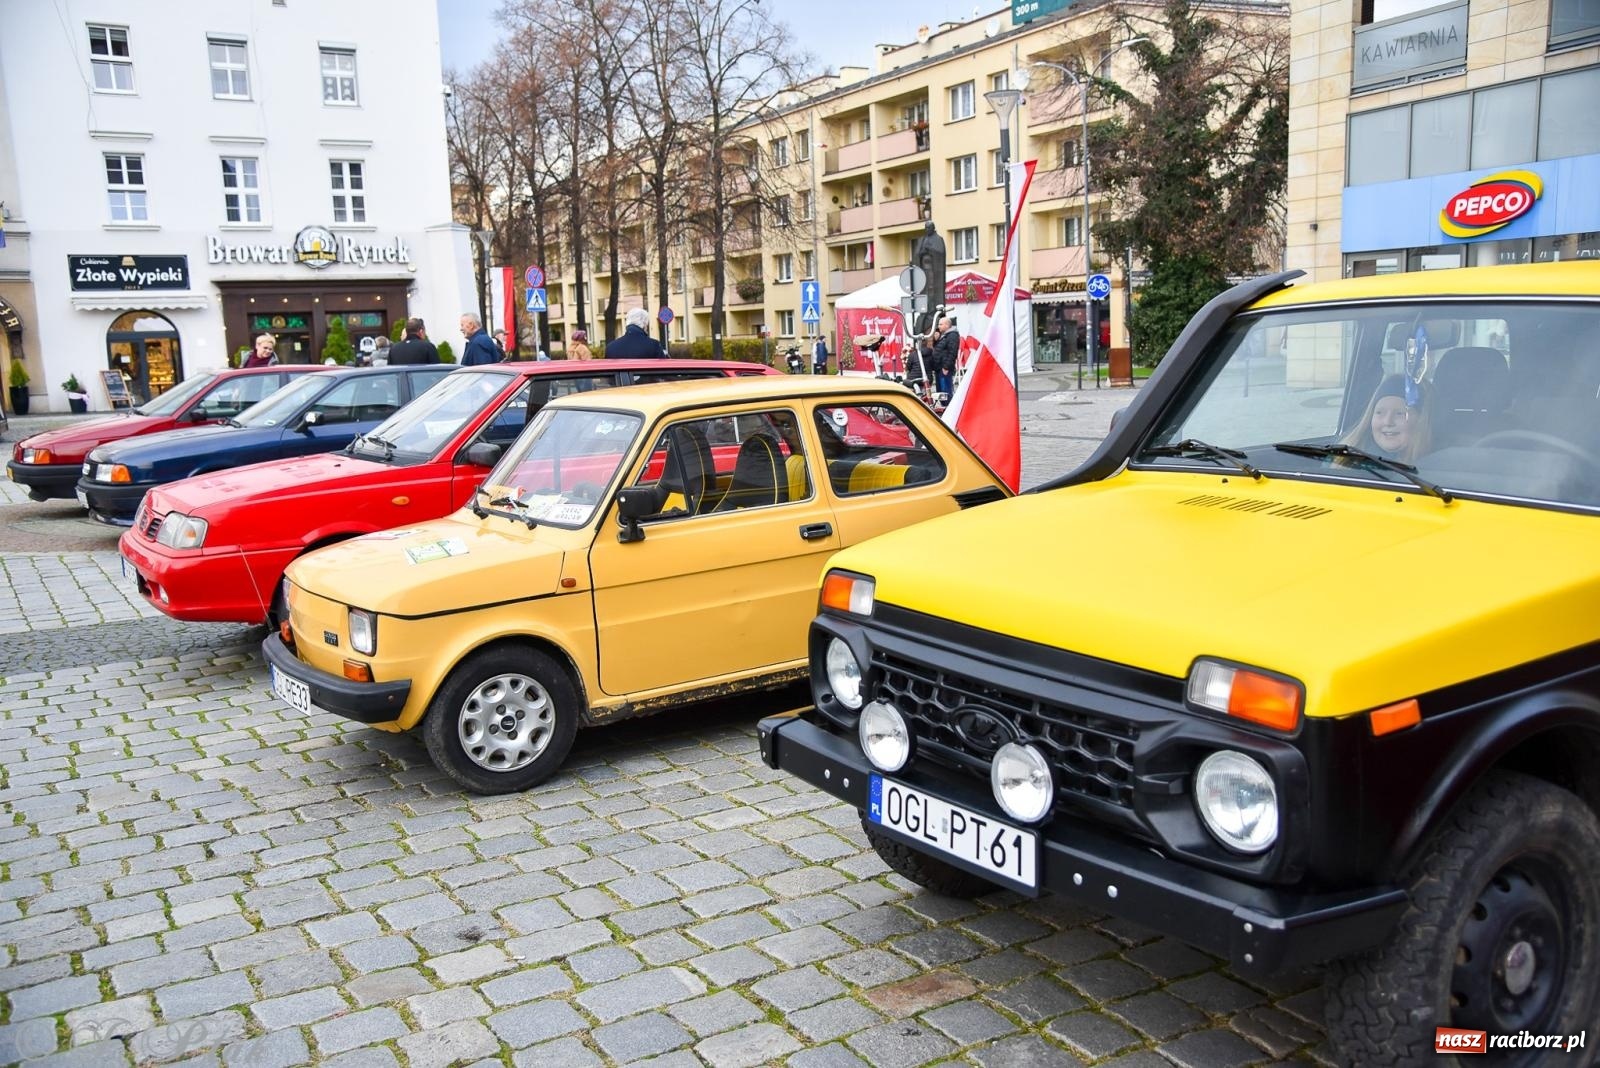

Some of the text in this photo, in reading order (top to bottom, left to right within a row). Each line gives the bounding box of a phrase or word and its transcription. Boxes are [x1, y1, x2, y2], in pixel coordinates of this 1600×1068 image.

[1015, 2, 1039, 16] 300 m
[1360, 25, 1459, 64] KAWIARNIA
[1453, 191, 1524, 218] PEPCO
[207, 235, 290, 265] Browar
[341, 235, 410, 267] Rynek
[75, 266, 183, 285] Złote Wypieki
[871, 802, 881, 817] PL
[887, 786, 1022, 877] OGL PT61
